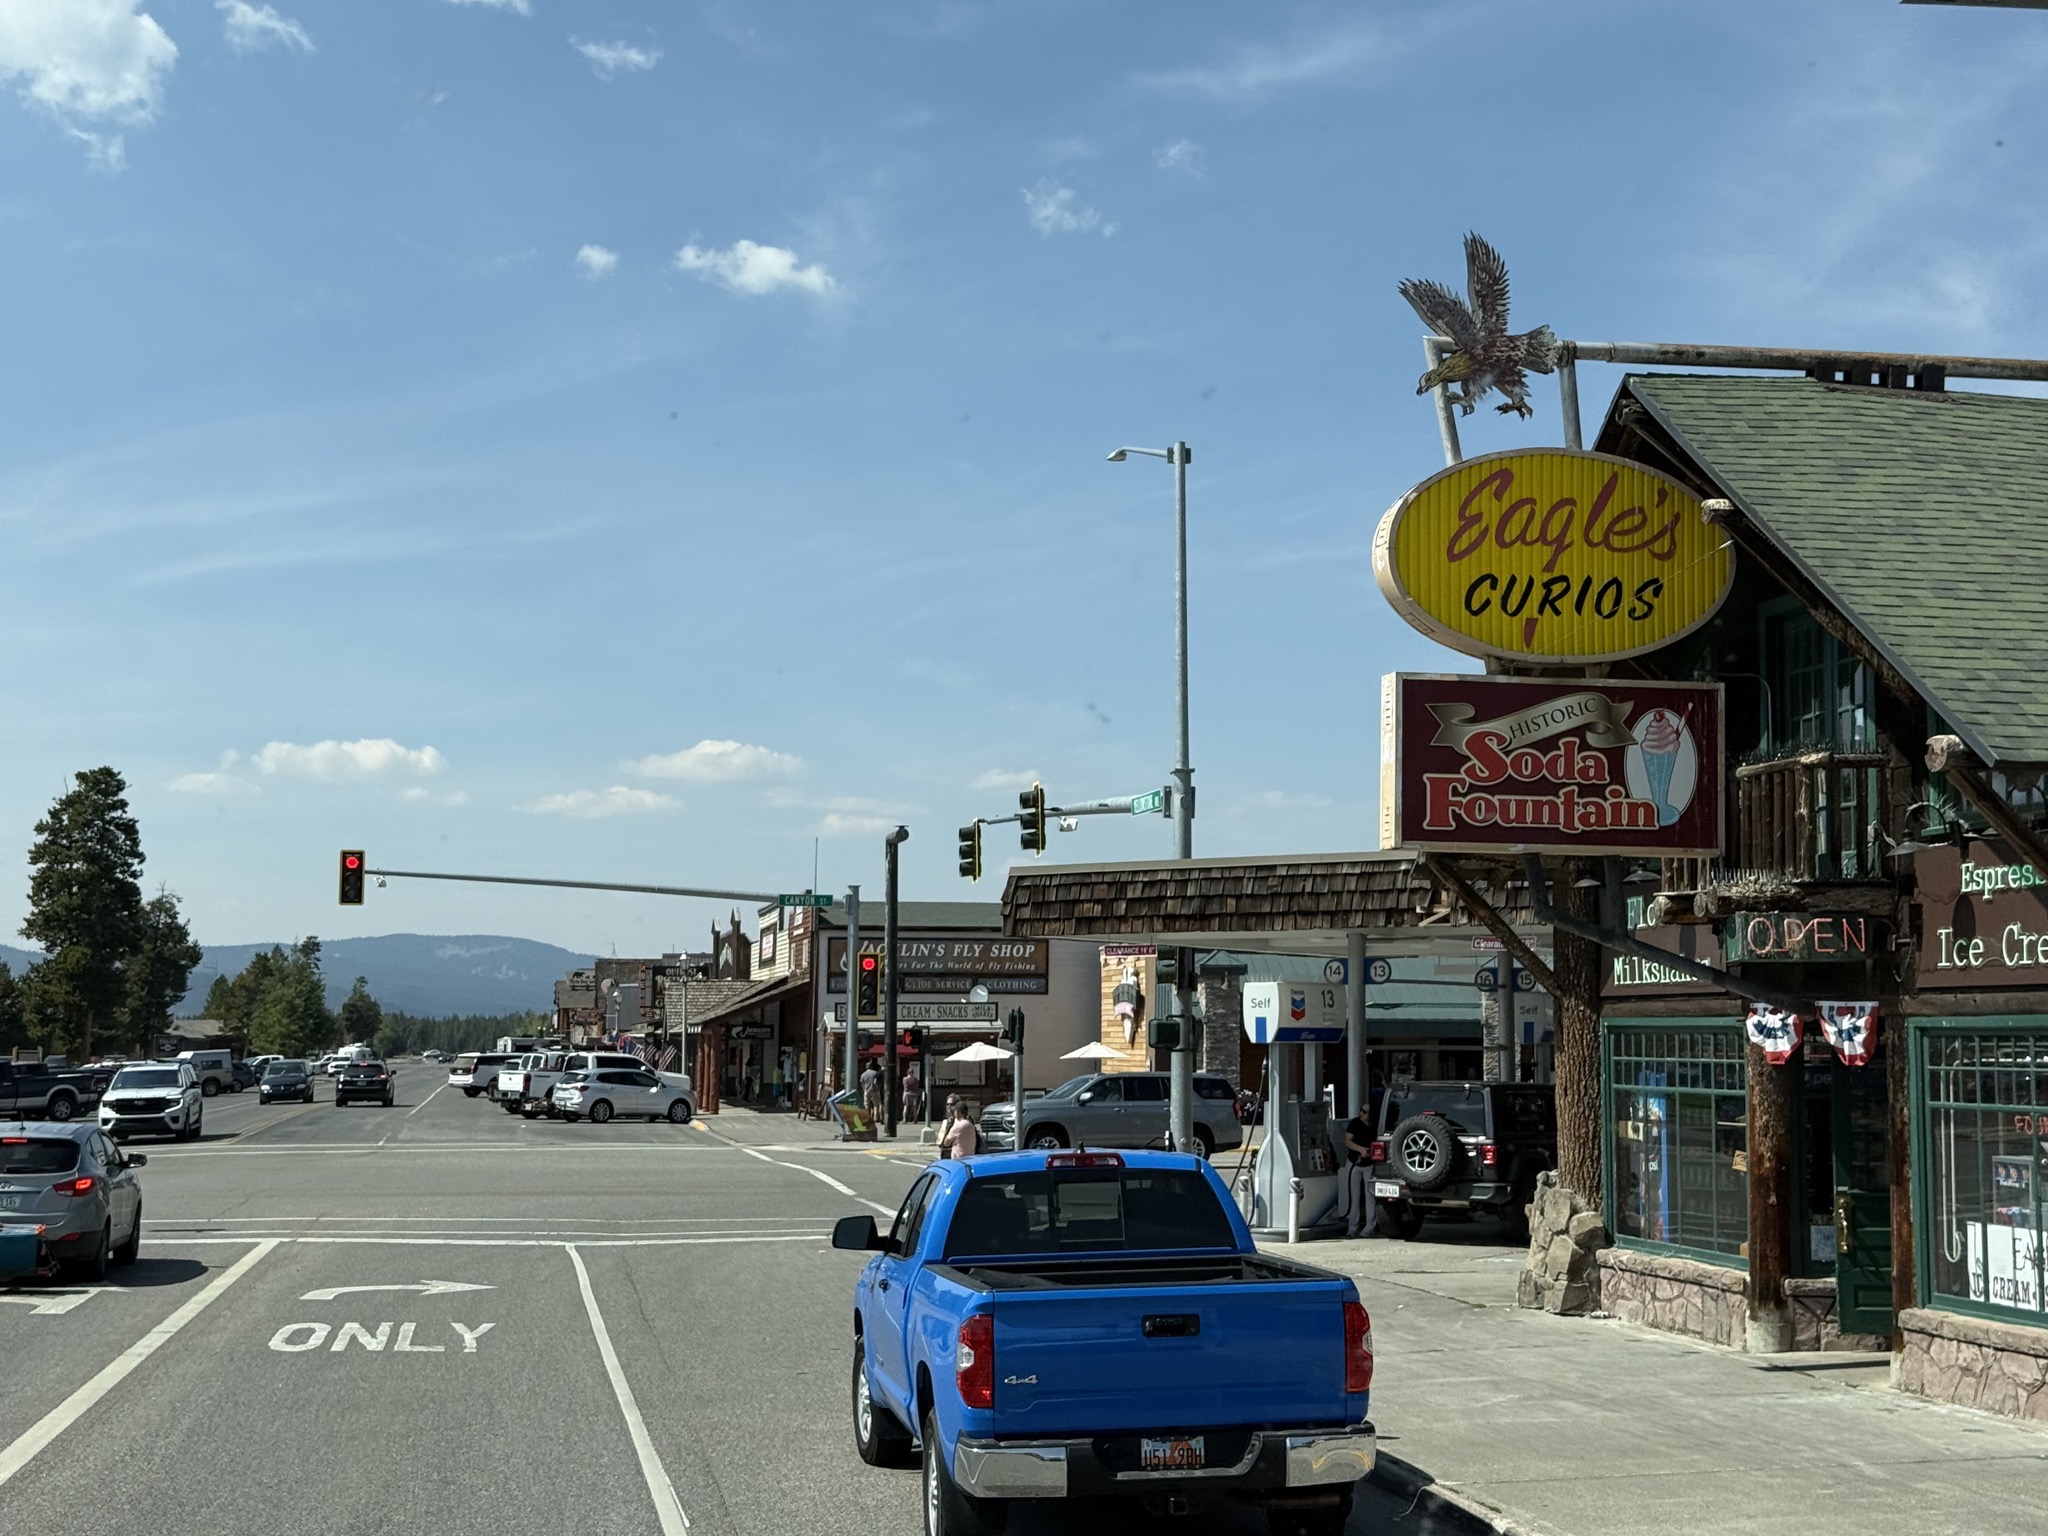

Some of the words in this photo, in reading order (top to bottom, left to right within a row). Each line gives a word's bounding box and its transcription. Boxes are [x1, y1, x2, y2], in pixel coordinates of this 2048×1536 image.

[1446, 467, 1681, 573] Eagle's
[1464, 573, 1664, 621] CURIOS
[1510, 698, 1598, 741] HISTORIC
[1461, 730, 1610, 785] Soda
[1423, 774, 1659, 832] Fountain
[785, 895, 816, 905] CANYON
[1747, 917, 1867, 953] OPEN
[953, 943, 984, 957] FLY
[989, 944, 1035, 957] SHOP
[1105, 946, 1139, 955] CLEARANCE
[1937, 926, 1984, 968] Ice
[911, 961, 927, 969] For
[929, 961, 944, 969] The
[947, 961, 972, 970] World
[975, 962, 984, 970] of
[988, 961, 1001, 970] Fly
[1004, 961, 1035, 971] Fishing
[1328, 965, 1342, 978] 14
[1372, 965, 1386, 978] 13
[906, 981, 931, 989] GUIDE
[936, 981, 971, 989] SERVICE
[986, 981, 1037, 989] CLOTHING
[1479, 974, 1492, 986] 16
[1519, 974, 1533, 986] 15
[1250, 997, 1272, 1009] Self
[1321, 989, 1335, 1009] 13
[901, 1005, 931, 1018] CREAM
[937, 1005, 969, 1019] SNACKS
[1520, 1005, 1538, 1015] Self
[1993, 1275, 2032, 1305] CREAM
[268, 1321, 497, 1353] ONLY
[1004, 1374, 1038, 1385] 4x4
